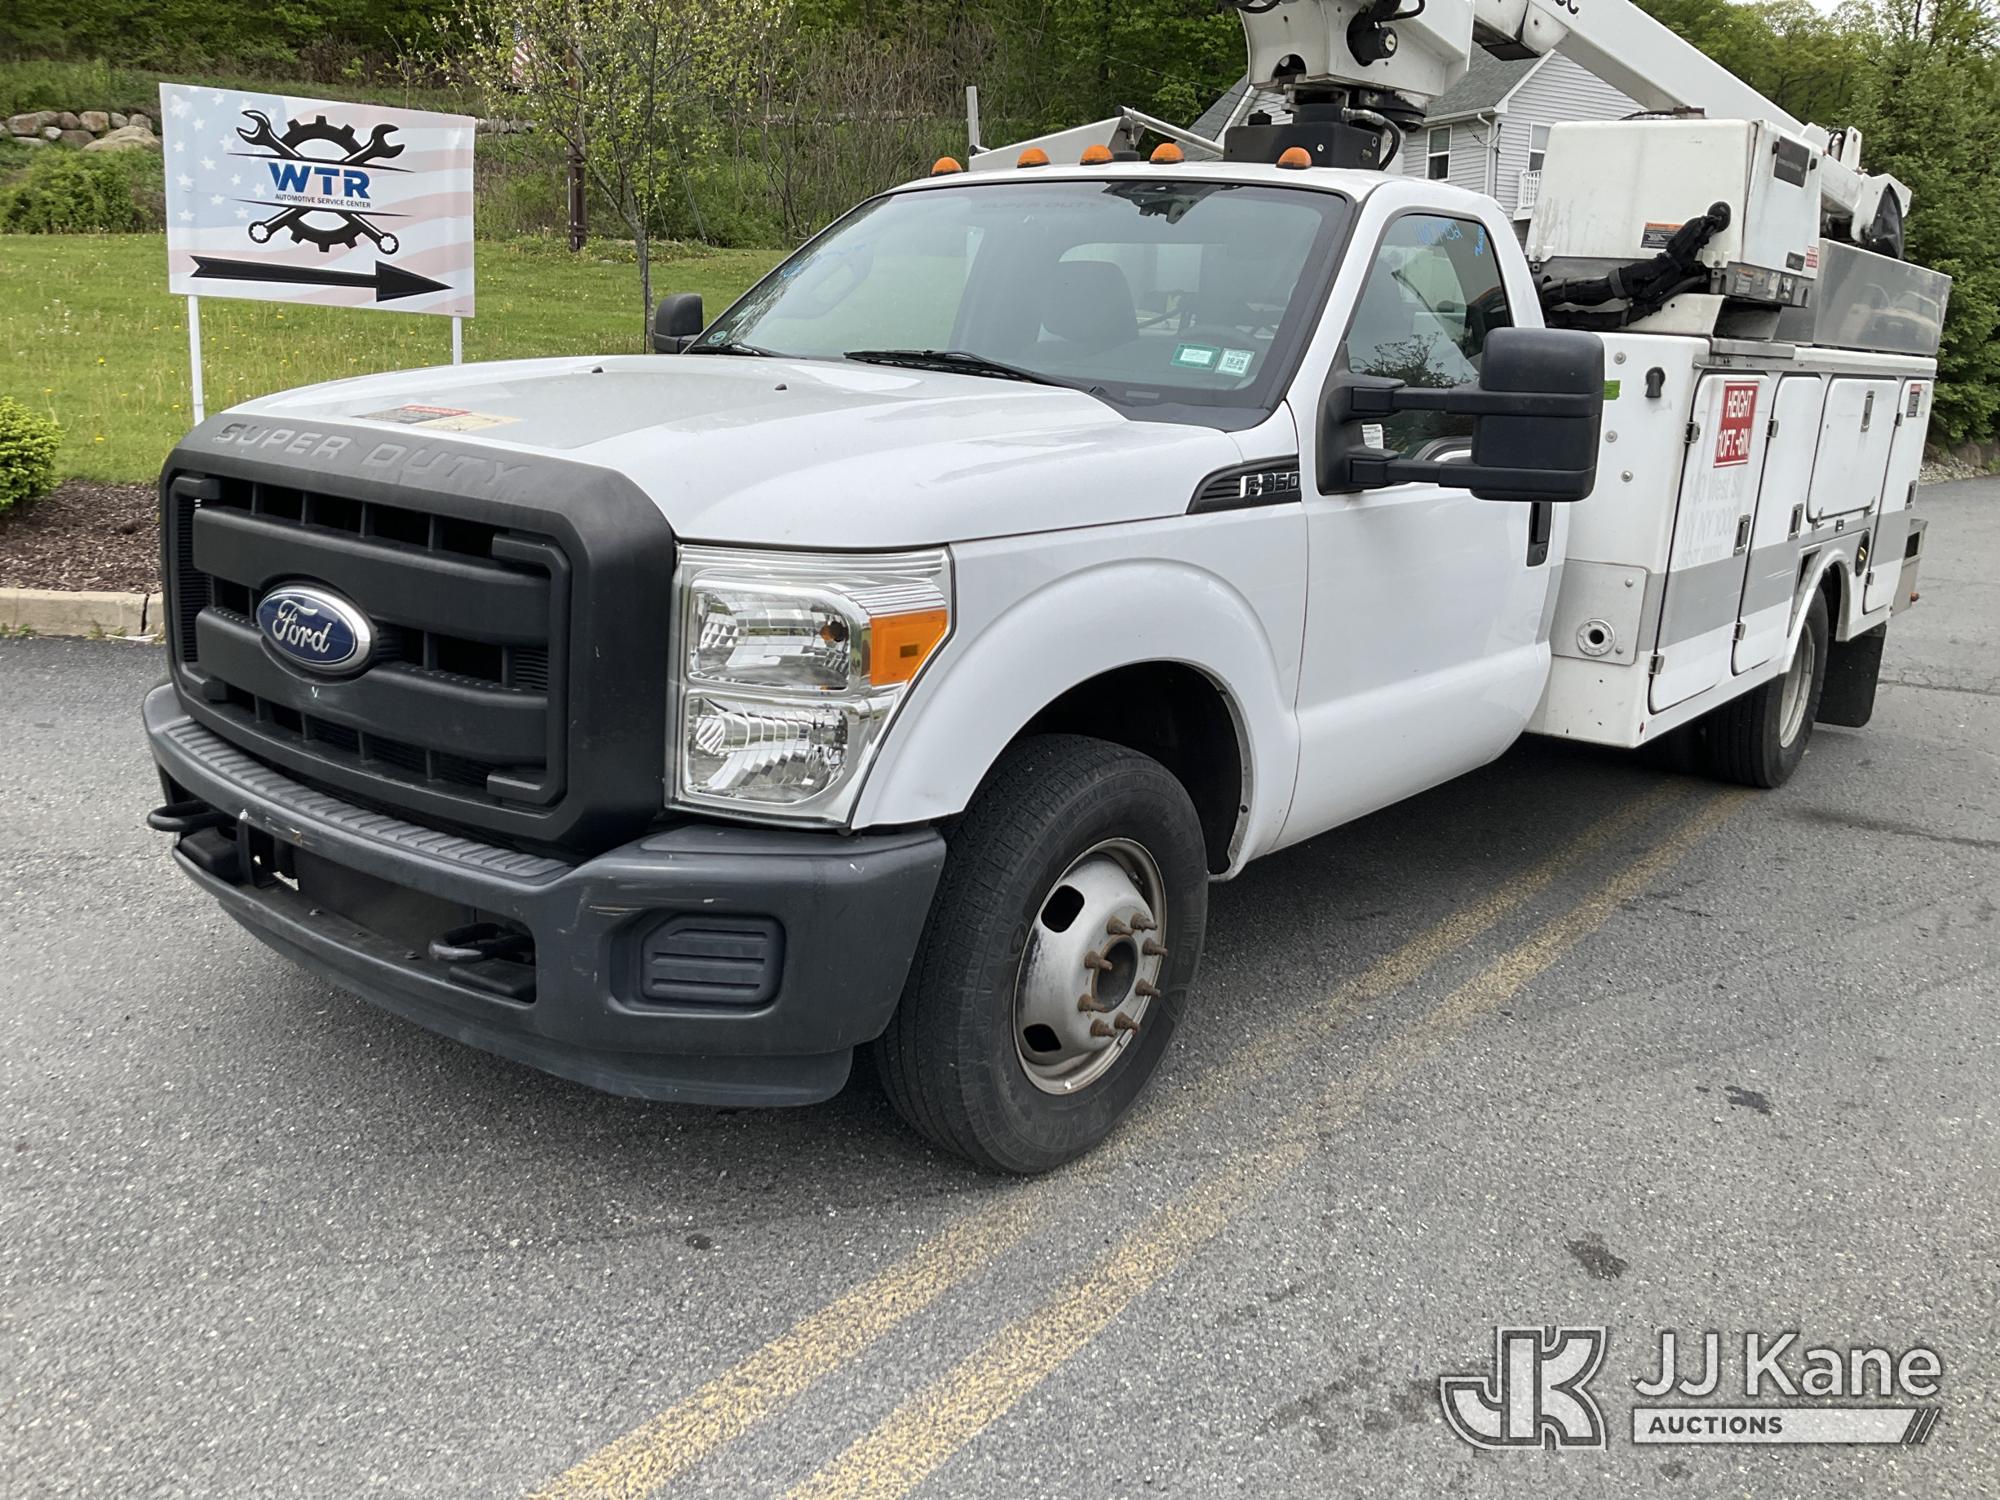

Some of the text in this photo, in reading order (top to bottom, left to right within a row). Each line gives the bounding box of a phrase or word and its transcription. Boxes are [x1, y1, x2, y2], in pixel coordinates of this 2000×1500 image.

[268, 162, 370, 199] WTR
[275, 193, 371, 208] AUTOMOTIVE SERVICE CENTER
[1726, 390, 1753, 418] HEIGHT
[212, 422, 532, 486] SUPER DUTY
[272, 599, 333, 653] Ford
